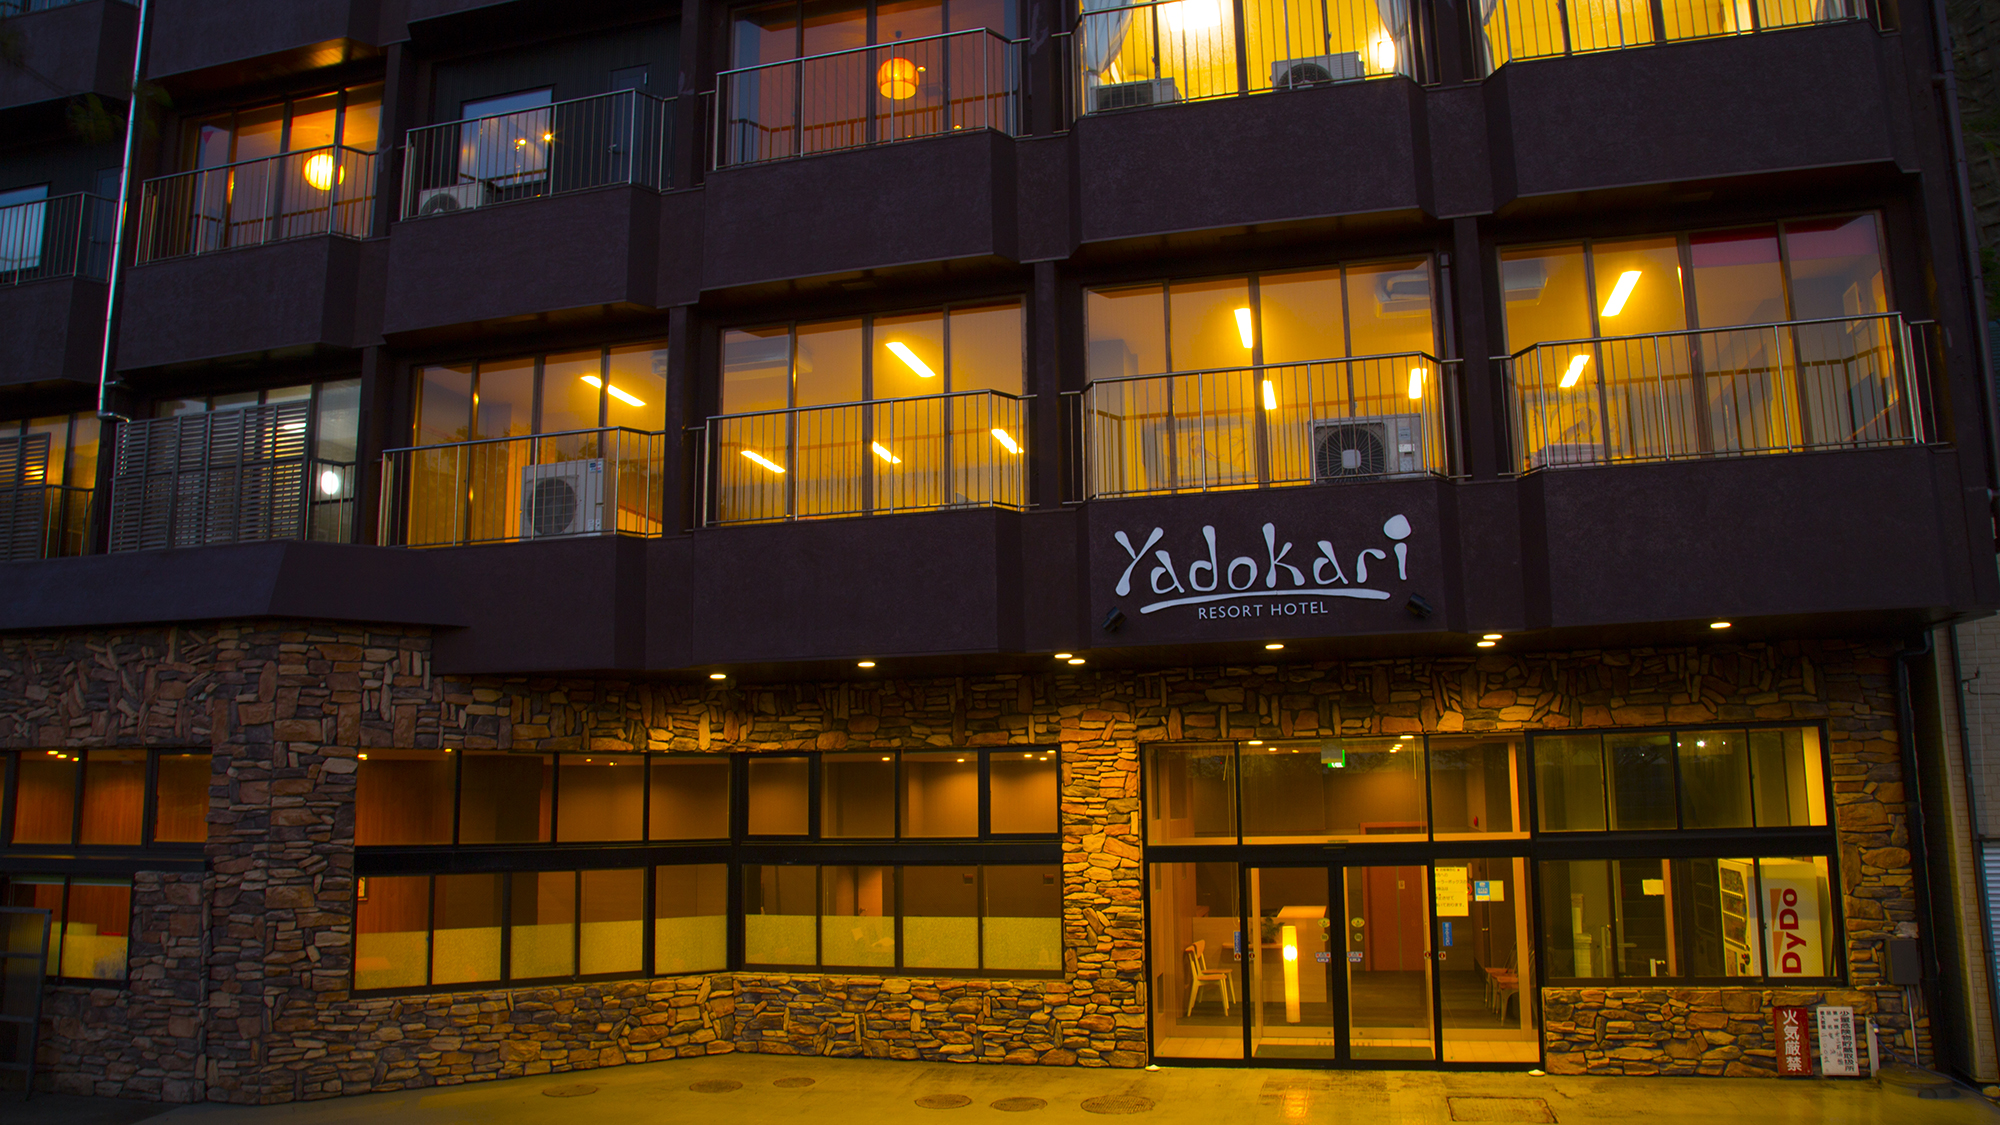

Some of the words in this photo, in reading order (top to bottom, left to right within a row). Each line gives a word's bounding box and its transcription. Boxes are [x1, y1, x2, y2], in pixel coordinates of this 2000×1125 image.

[1114, 513, 1412, 597] Yadokari
[1198, 604, 1263, 620] RESORT
[1270, 601, 1329, 617] HOTEL
[1779, 888, 1807, 974] DyDo
[1782, 1009, 1802, 1072] 火気厳禁
[1839, 1010, 1855, 1072] 少量危険物貯蔵取扱所
